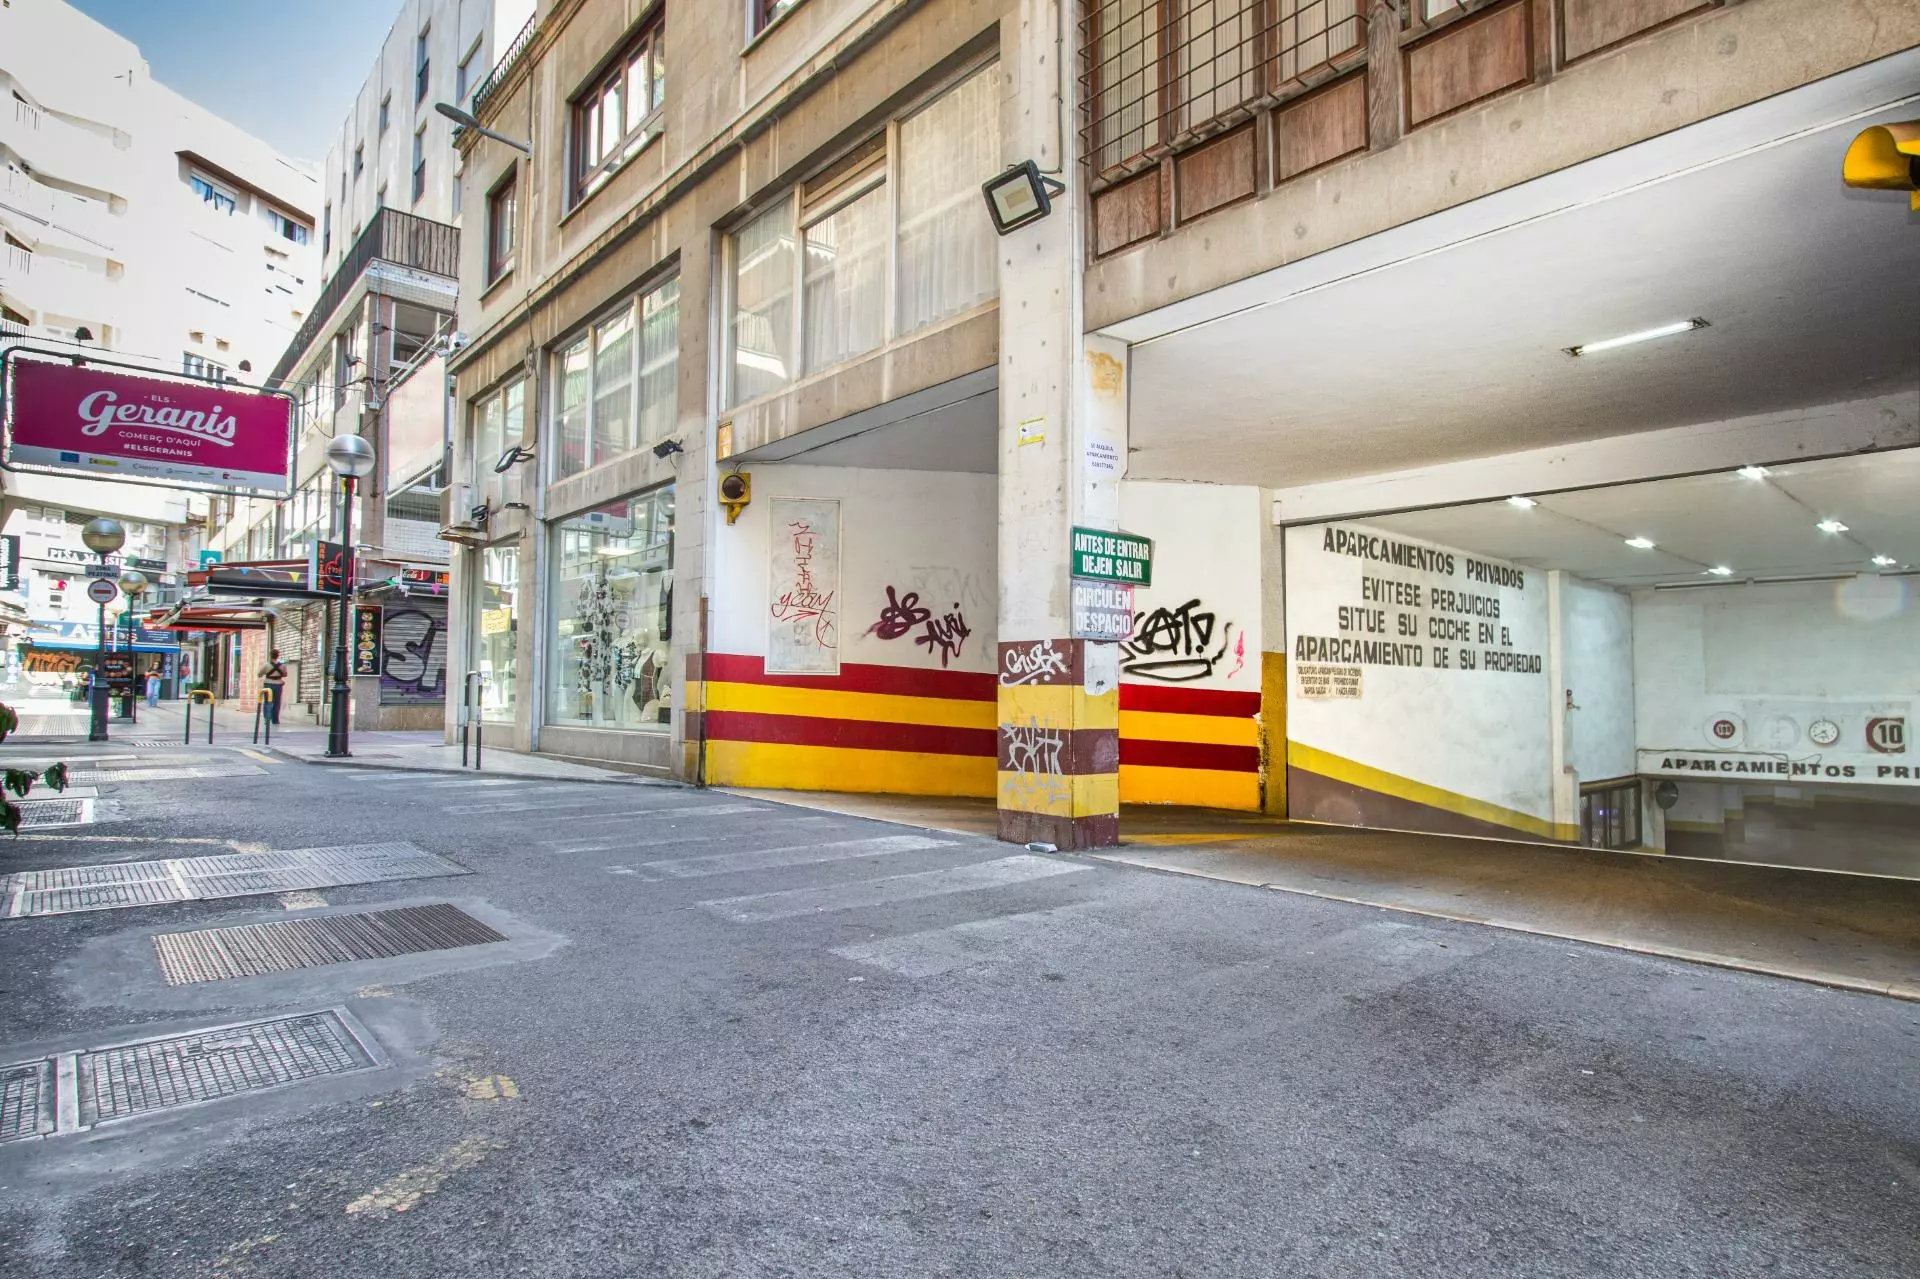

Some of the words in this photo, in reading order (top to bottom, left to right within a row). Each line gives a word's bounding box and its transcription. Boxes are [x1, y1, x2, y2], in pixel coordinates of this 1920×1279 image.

[151, 395, 170, 404] ELS
[78, 390, 236, 447] Geranis
[118, 430, 163, 444] COMERÇ
[123, 443, 193, 457] #ELSGERANIS
[1075, 533, 1103, 554] ANTES
[1104, 537, 1116, 556] DE
[1117, 540, 1149, 560] ENTRAR
[1323, 528, 1455, 576] APARCAMIENTOS
[1466, 559, 1524, 589] PRIVADOS
[1082, 554, 1112, 576] DEJEN
[1116, 559, 1142, 579] SALIR
[1075, 586, 1131, 610] CIRCULEN
[1362, 576, 1421, 607] EVITESE
[1431, 588, 1500, 619] PERJUICIOS
[1075, 611, 1131, 634] DESPACIO
[1338, 606, 1385, 633] SITUE
[1398, 613, 1417, 637] SU
[1429, 616, 1470, 642] COCHE
[1478, 622, 1494, 645] EN
[1501, 626, 1513, 647] EL
[1295, 635, 1422, 667] APARCAMIENTO
[1433, 647, 1449, 669] DE
[1460, 649, 1475, 670] SU
[1485, 651, 1542, 674] PROPIEDAD
[1878, 724, 1903, 744] 10
[1661, 757, 1856, 778] APARCAMIENTOS
